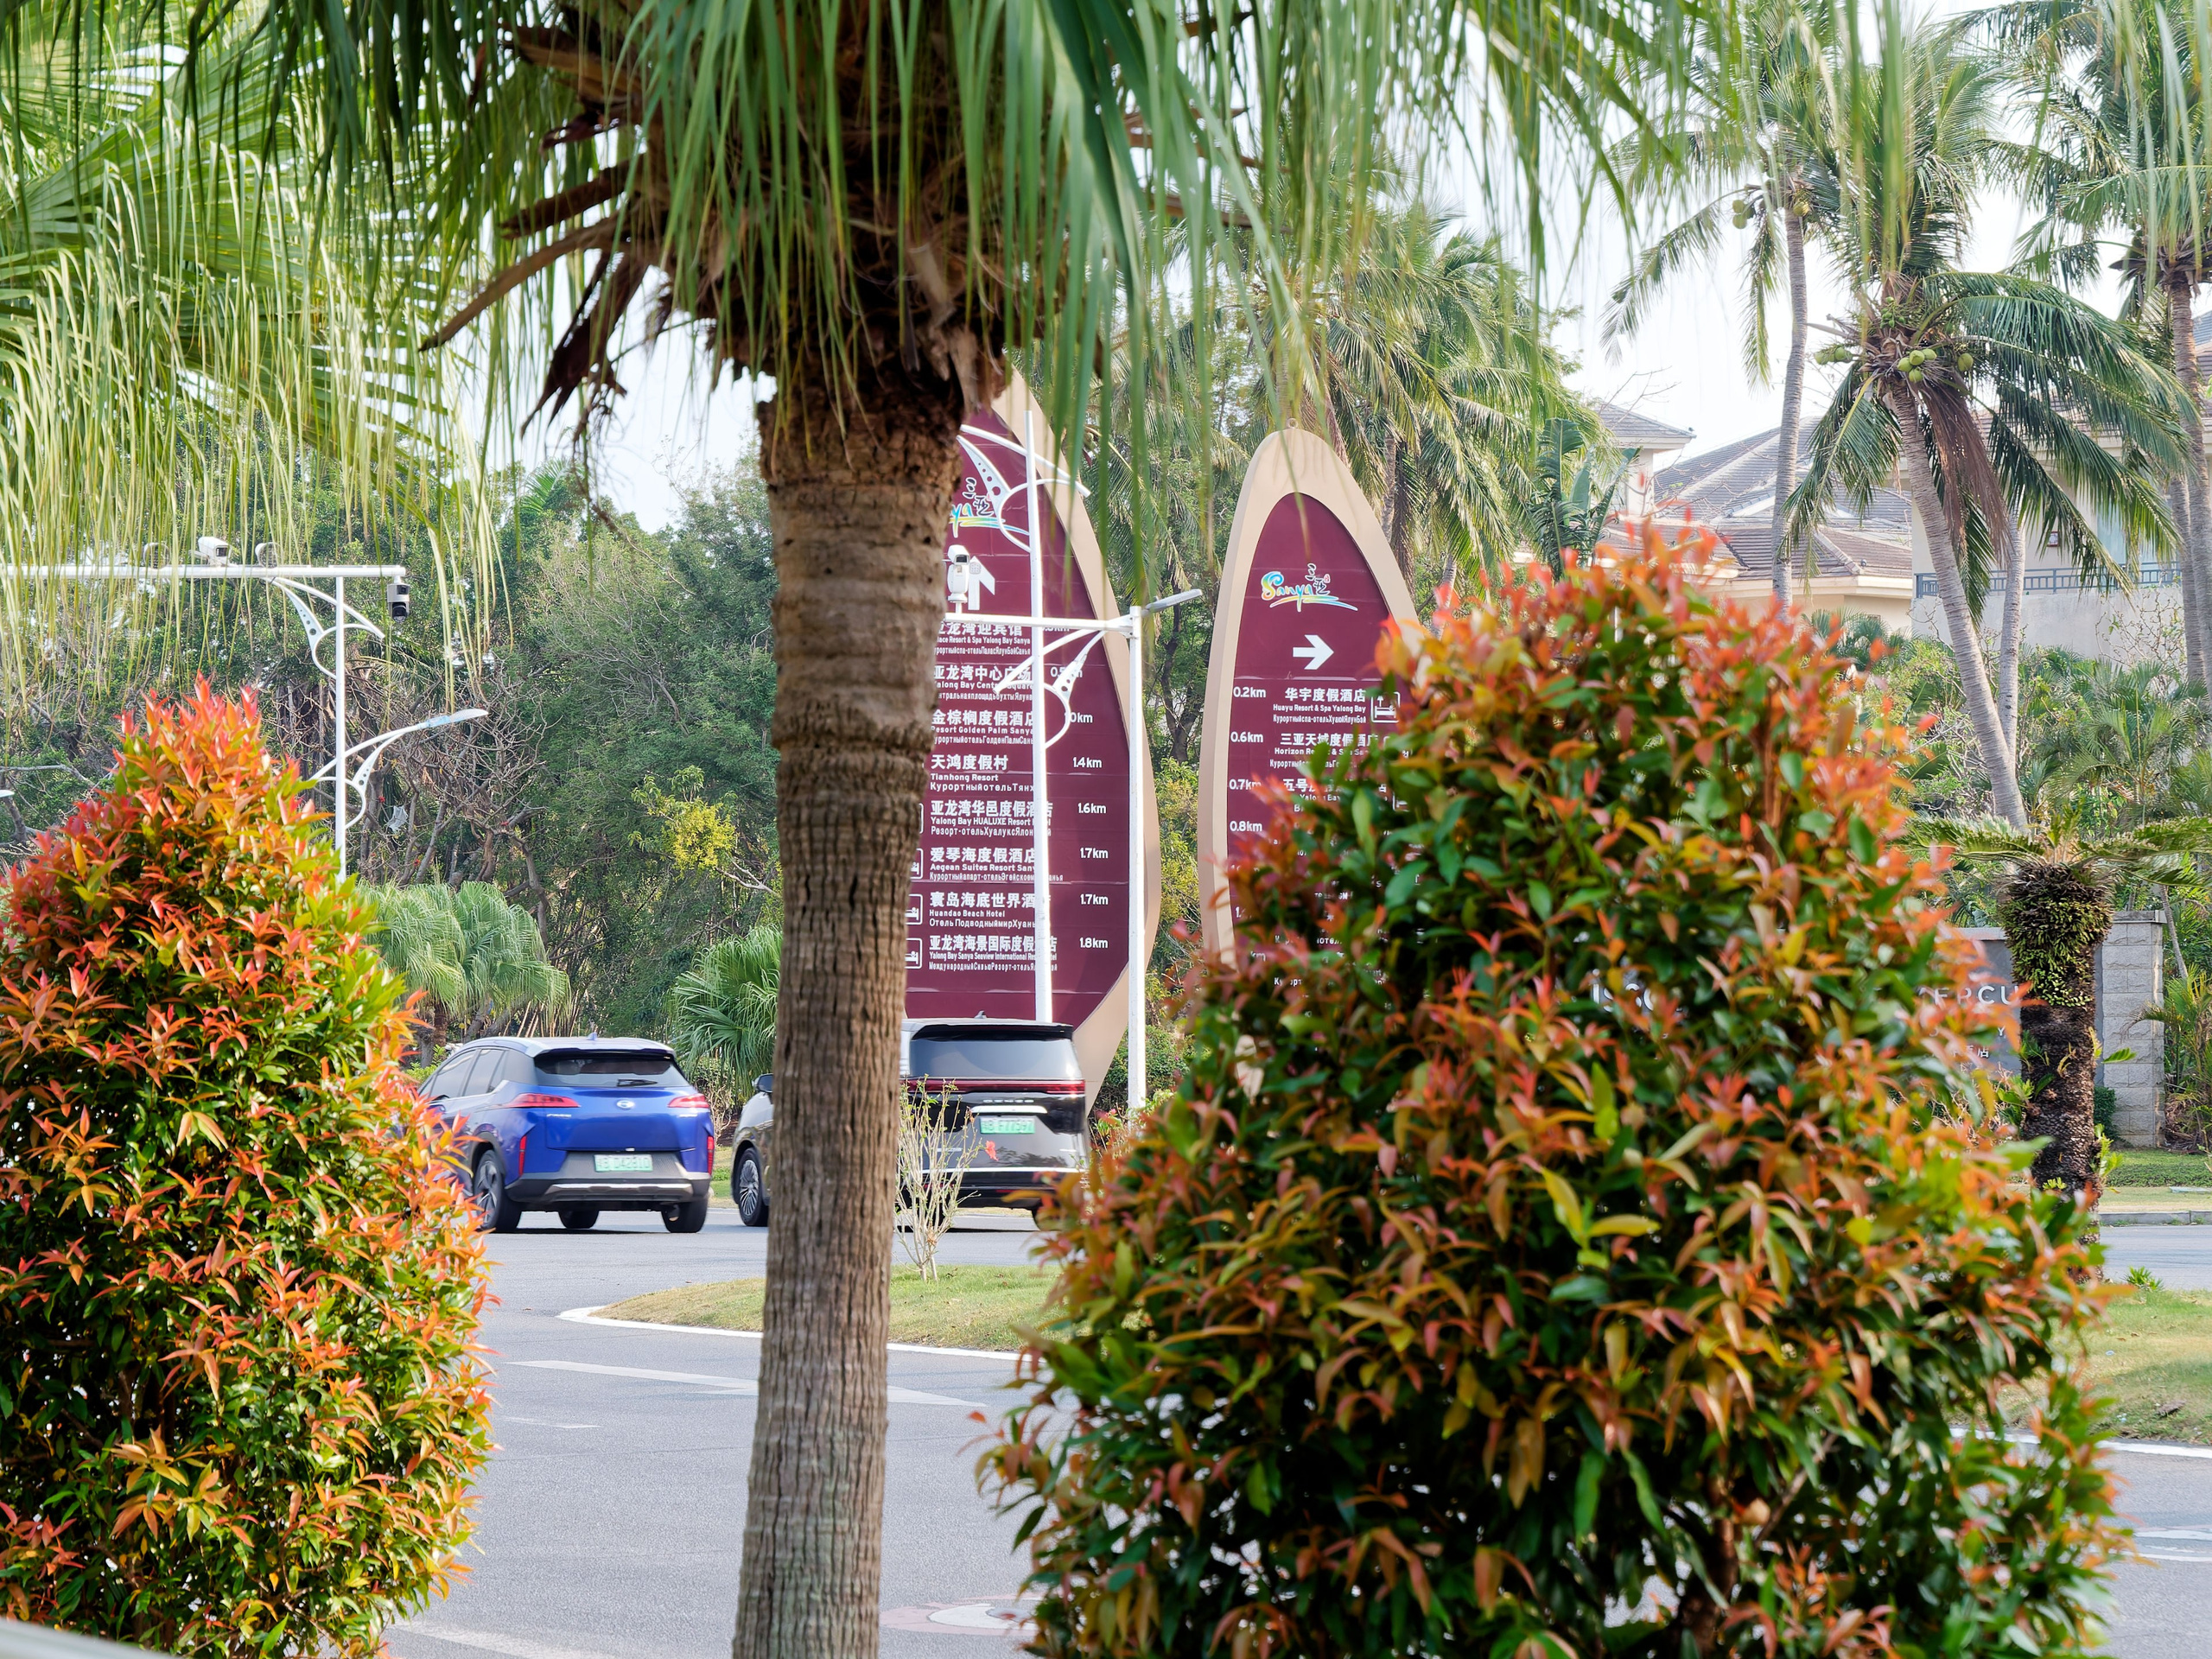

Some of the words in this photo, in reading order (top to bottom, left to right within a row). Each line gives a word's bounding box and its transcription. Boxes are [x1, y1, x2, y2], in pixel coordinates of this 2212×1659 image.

[1261, 571, 1313, 613] Sanya
[983, 637, 1001, 645] Yalong
[1002, 637, 1014, 645] Bay
[1014, 638, 1031, 646] Sanya
[934, 681, 958, 690] along
[1233, 686, 1267, 698] 0.2km
[1285, 687, 1366, 702] 华宇度假酒店
[1273, 704, 1293, 713] Huayu
[1319, 704, 1332, 713] Spa
[1332, 705, 1353, 714] Yalong
[1354, 705, 1366, 714] Bay
[1230, 731, 1263, 743] 0.6km
[1332, 747, 1337, 756] &
[931, 754, 1008, 771] 天鸿度假村
[1072, 757, 1103, 768] 1.4km
[931, 773, 969, 782] Tianhong
[1077, 802, 1107, 814] 1.6km
[931, 817, 957, 826] Yalong
[957, 817, 972, 827] Bay
[1230, 820, 1262, 832] 0.8km
[930, 847, 1034, 863] 爱琴海度假酒店
[1079, 847, 1109, 858] 1.7km
[930, 863, 960, 873] Aegean
[930, 892, 1051, 908] 寰岛海底世界酒
[1079, 893, 1109, 905] 1.7km
[929, 935, 1058, 952] 亚龙湾海景国际度假店
[1079, 937, 1109, 949] 1.8km
[930, 952, 947, 961] Yalong
[947, 952, 957, 961] Bay
[957, 952, 974, 962] Sanya
[995, 952, 1027, 961] International
